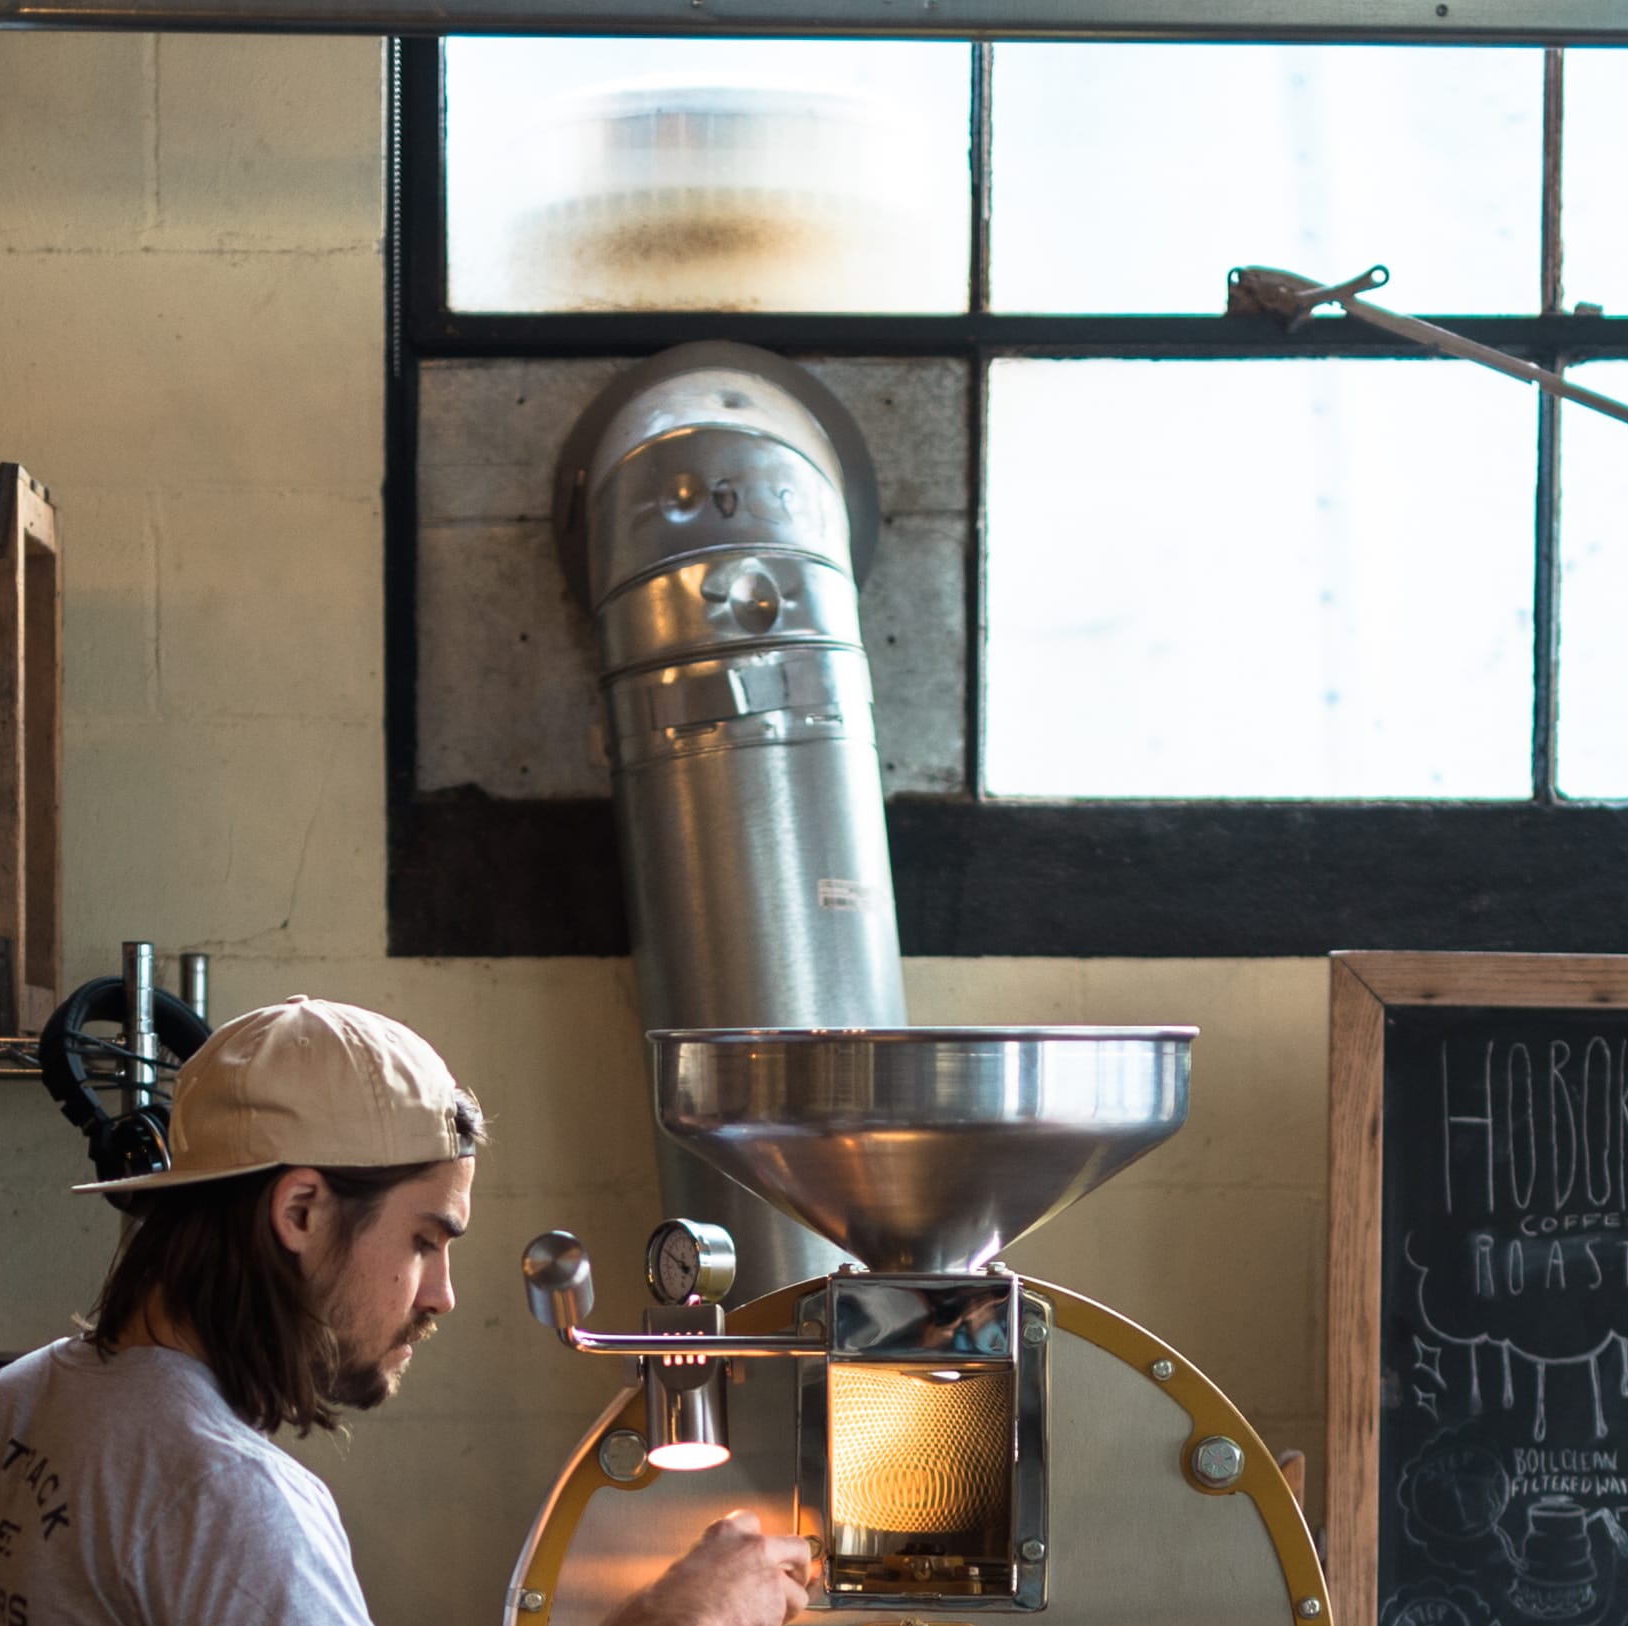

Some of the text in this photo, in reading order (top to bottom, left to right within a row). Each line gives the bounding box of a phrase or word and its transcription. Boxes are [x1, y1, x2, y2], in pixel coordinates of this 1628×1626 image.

[1512, 1447, 1619, 1475] BOIL CLEAN
[1510, 1474, 1592, 1498] FILTERED
